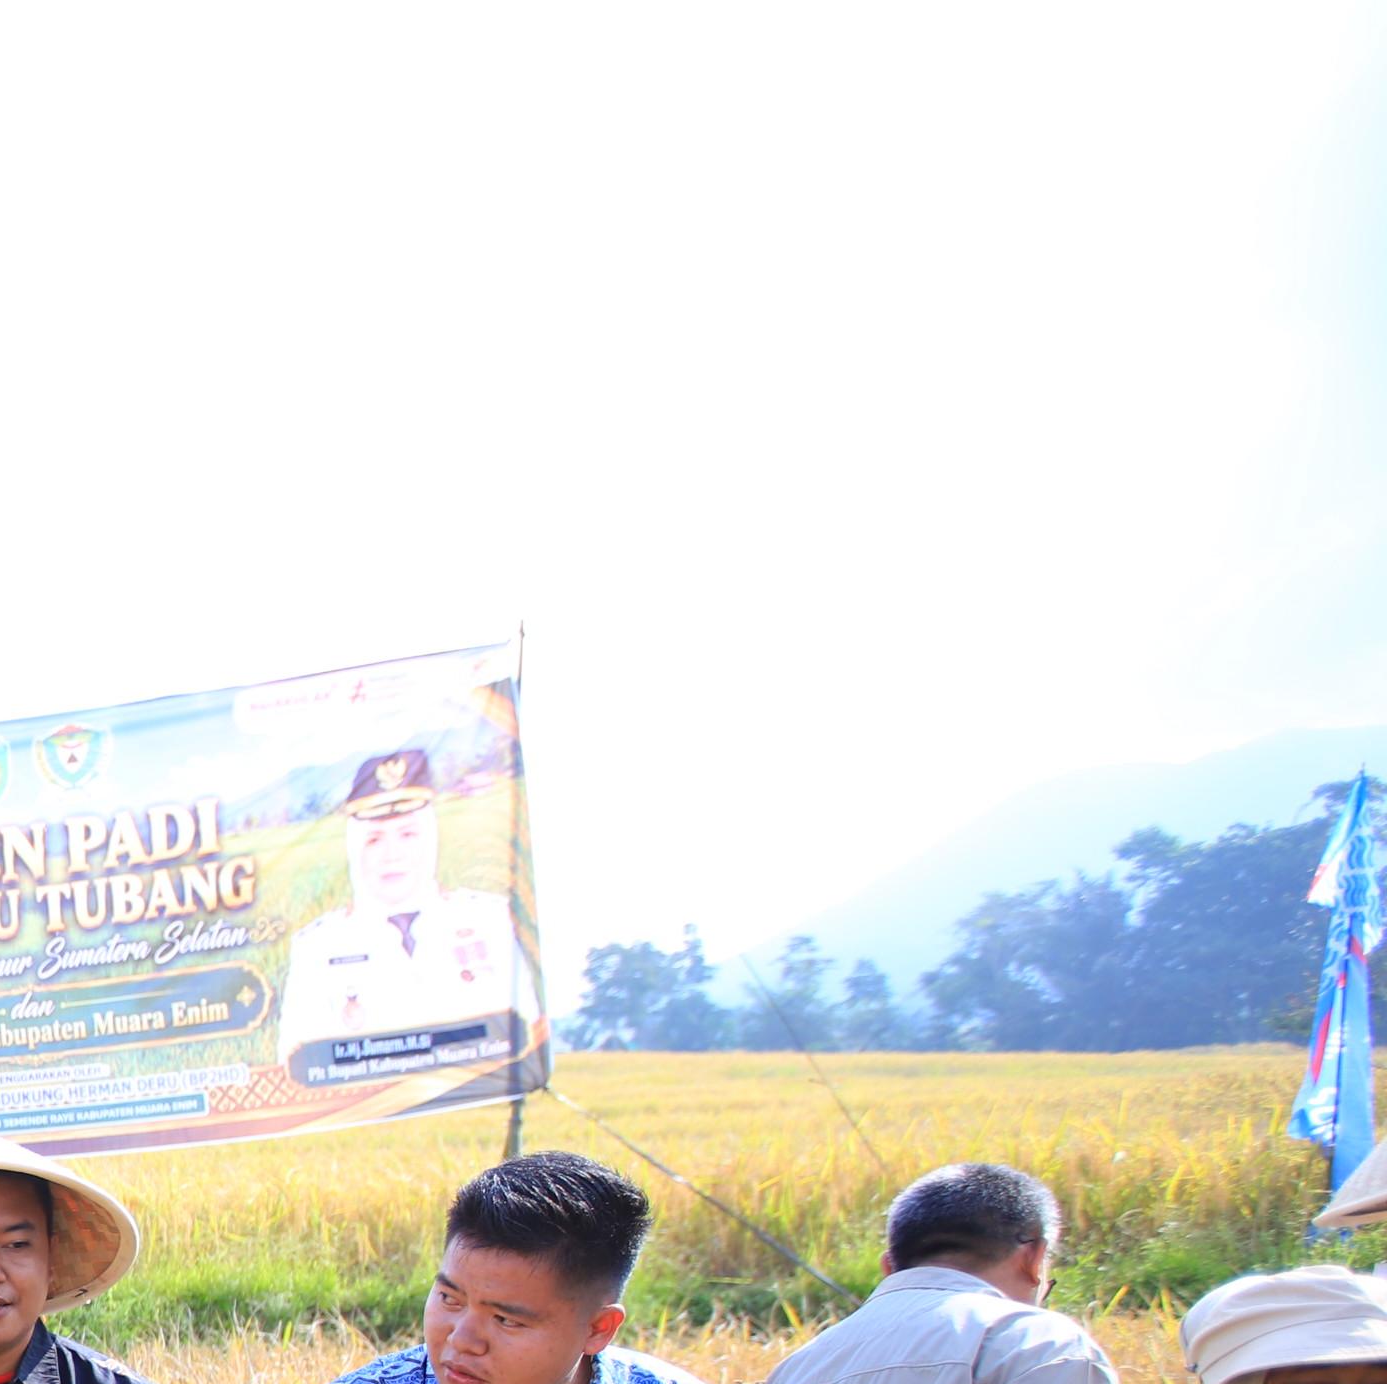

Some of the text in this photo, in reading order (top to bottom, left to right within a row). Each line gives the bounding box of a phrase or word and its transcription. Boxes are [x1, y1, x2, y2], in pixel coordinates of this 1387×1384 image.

[65, 797, 221, 874] PADI
[36, 855, 256, 933] TUBANG
[37, 932, 152, 979] Sumatera
[154, 918, 248, 964] Selatan
[10, 991, 55, 1020] dan
[92, 1009, 165, 1036] Muara
[170, 998, 229, 1026] Enim
[69, 1082, 131, 1098] HERMAN
[137, 1076, 176, 1091] DERU
[182, 1064, 249, 1088] (BP2HD)
[78, 1107, 134, 1121] KABUPATEN
